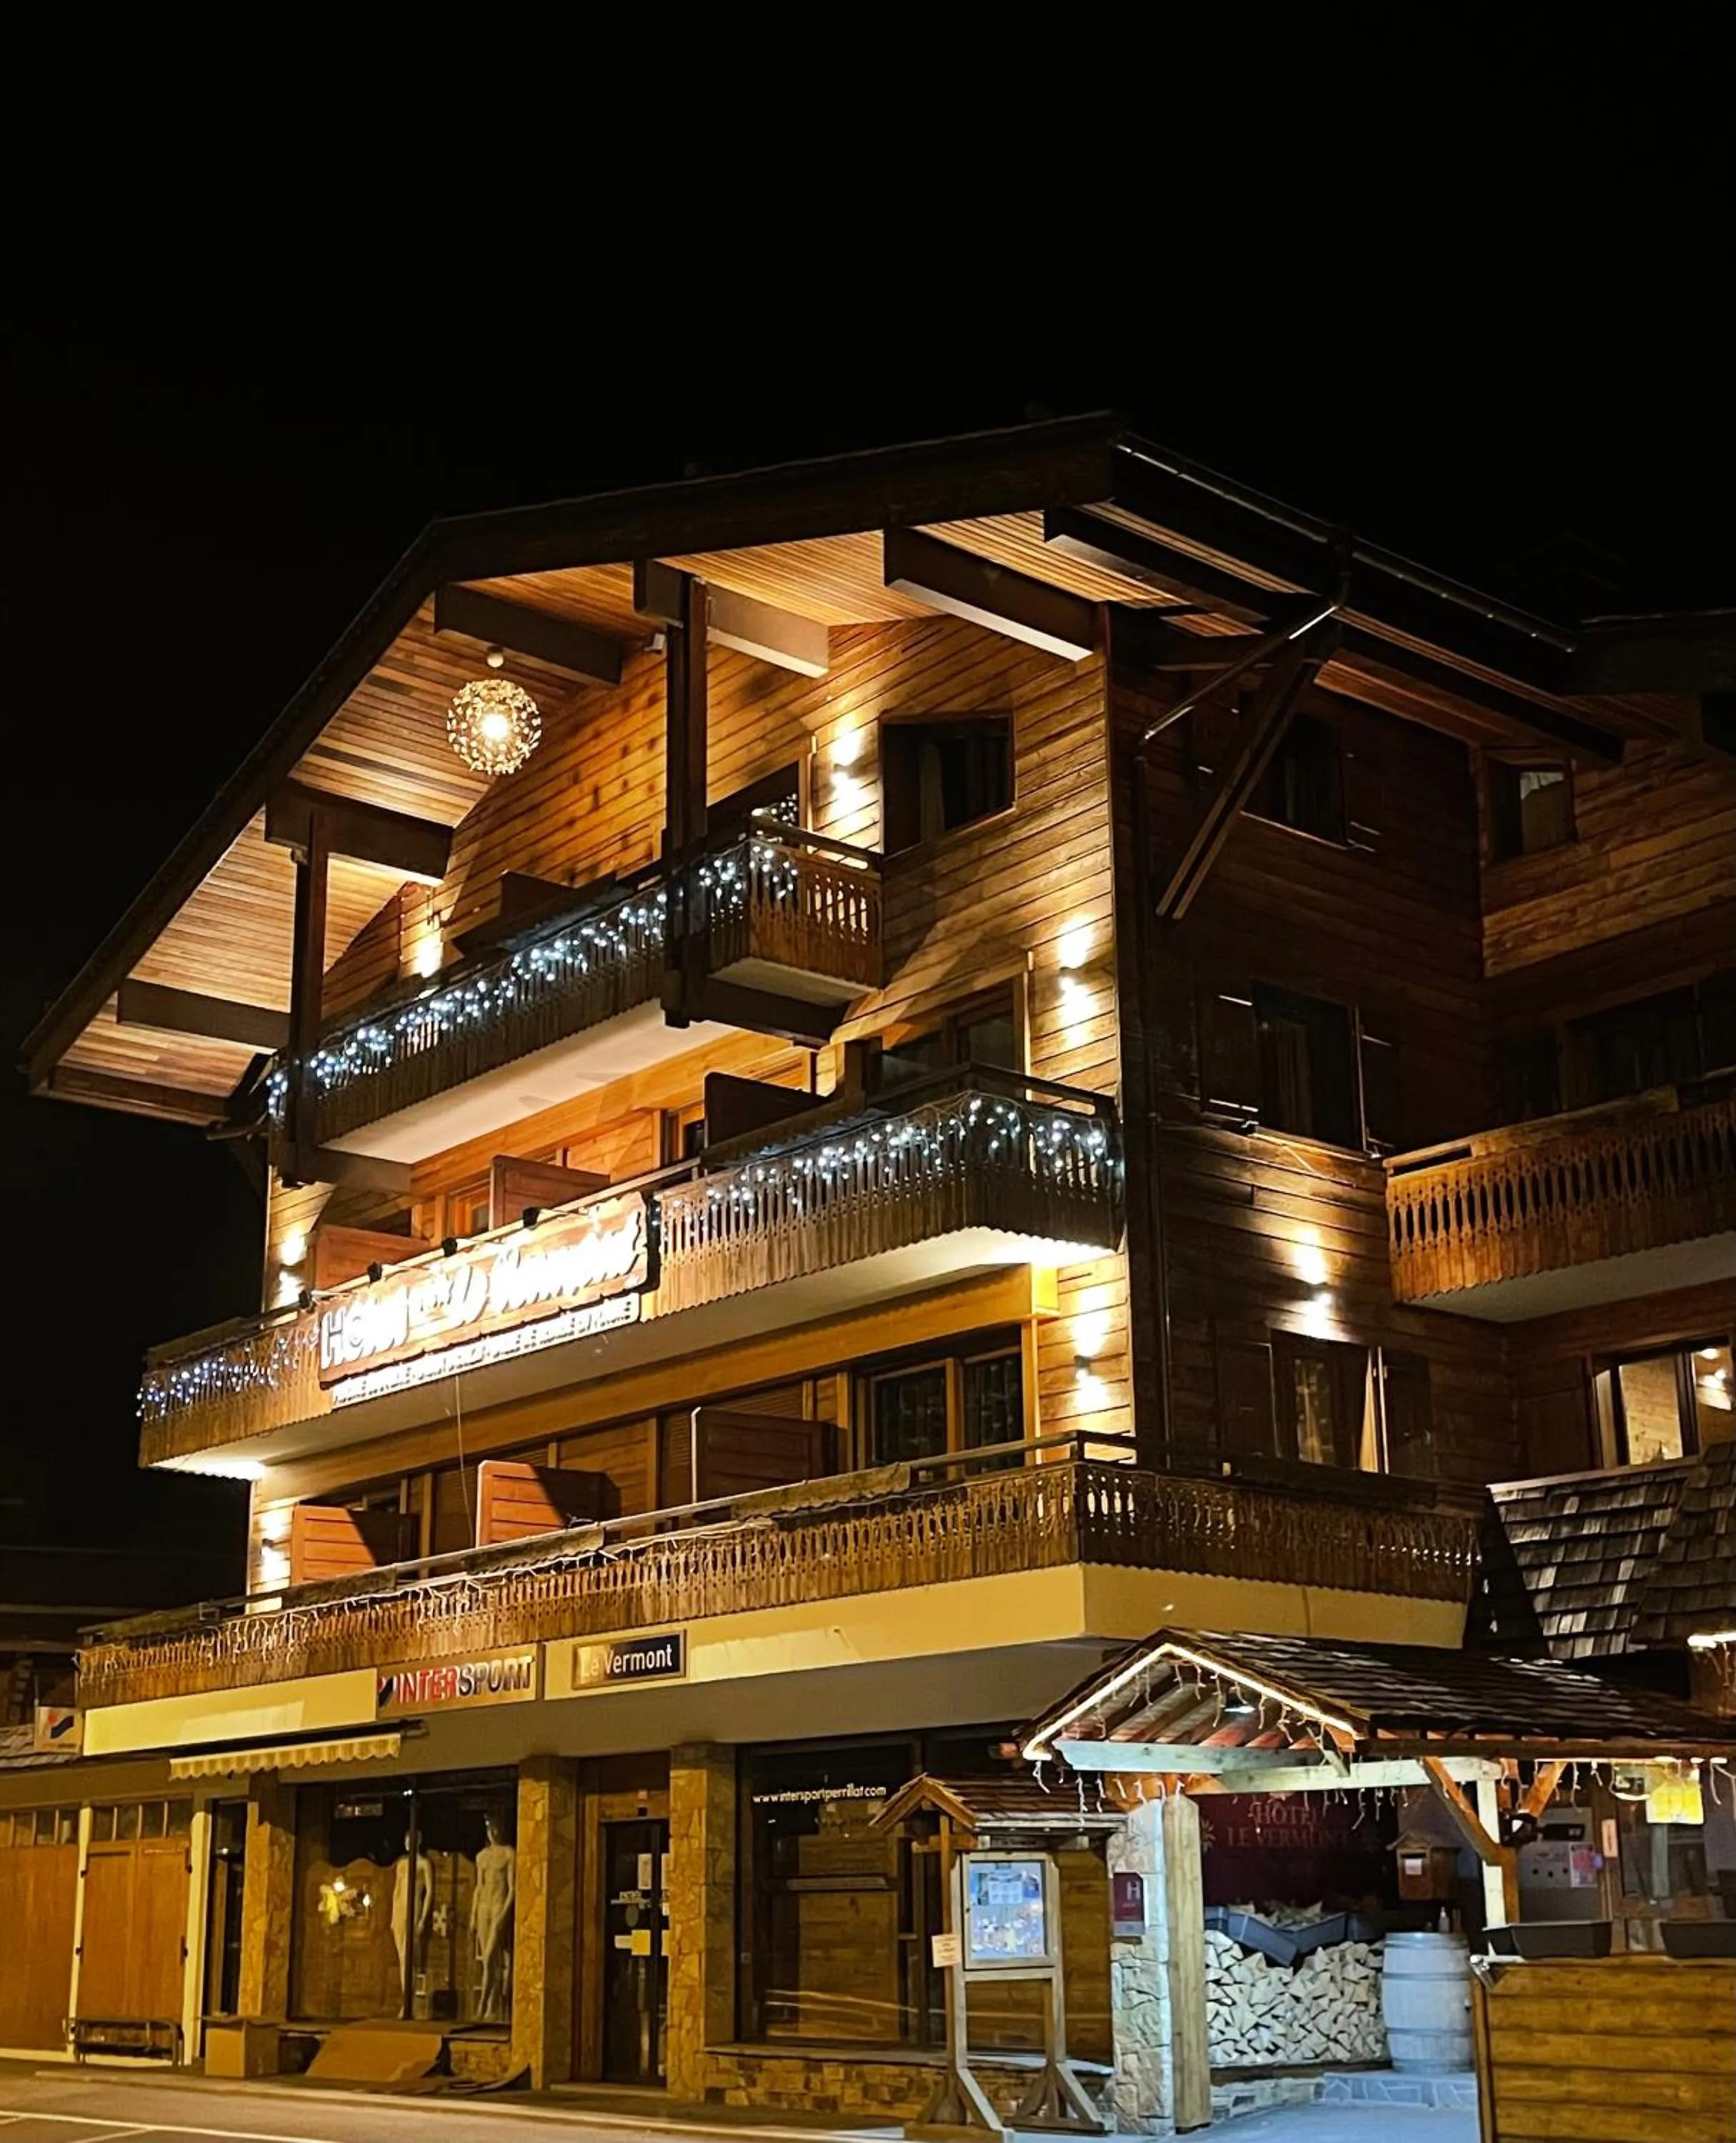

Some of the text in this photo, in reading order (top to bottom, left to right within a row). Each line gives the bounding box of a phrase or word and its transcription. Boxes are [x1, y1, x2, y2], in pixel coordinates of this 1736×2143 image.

[396, 1654, 533, 1704] INTERSPORT
[580, 1643, 672, 1679] Le Vermont
